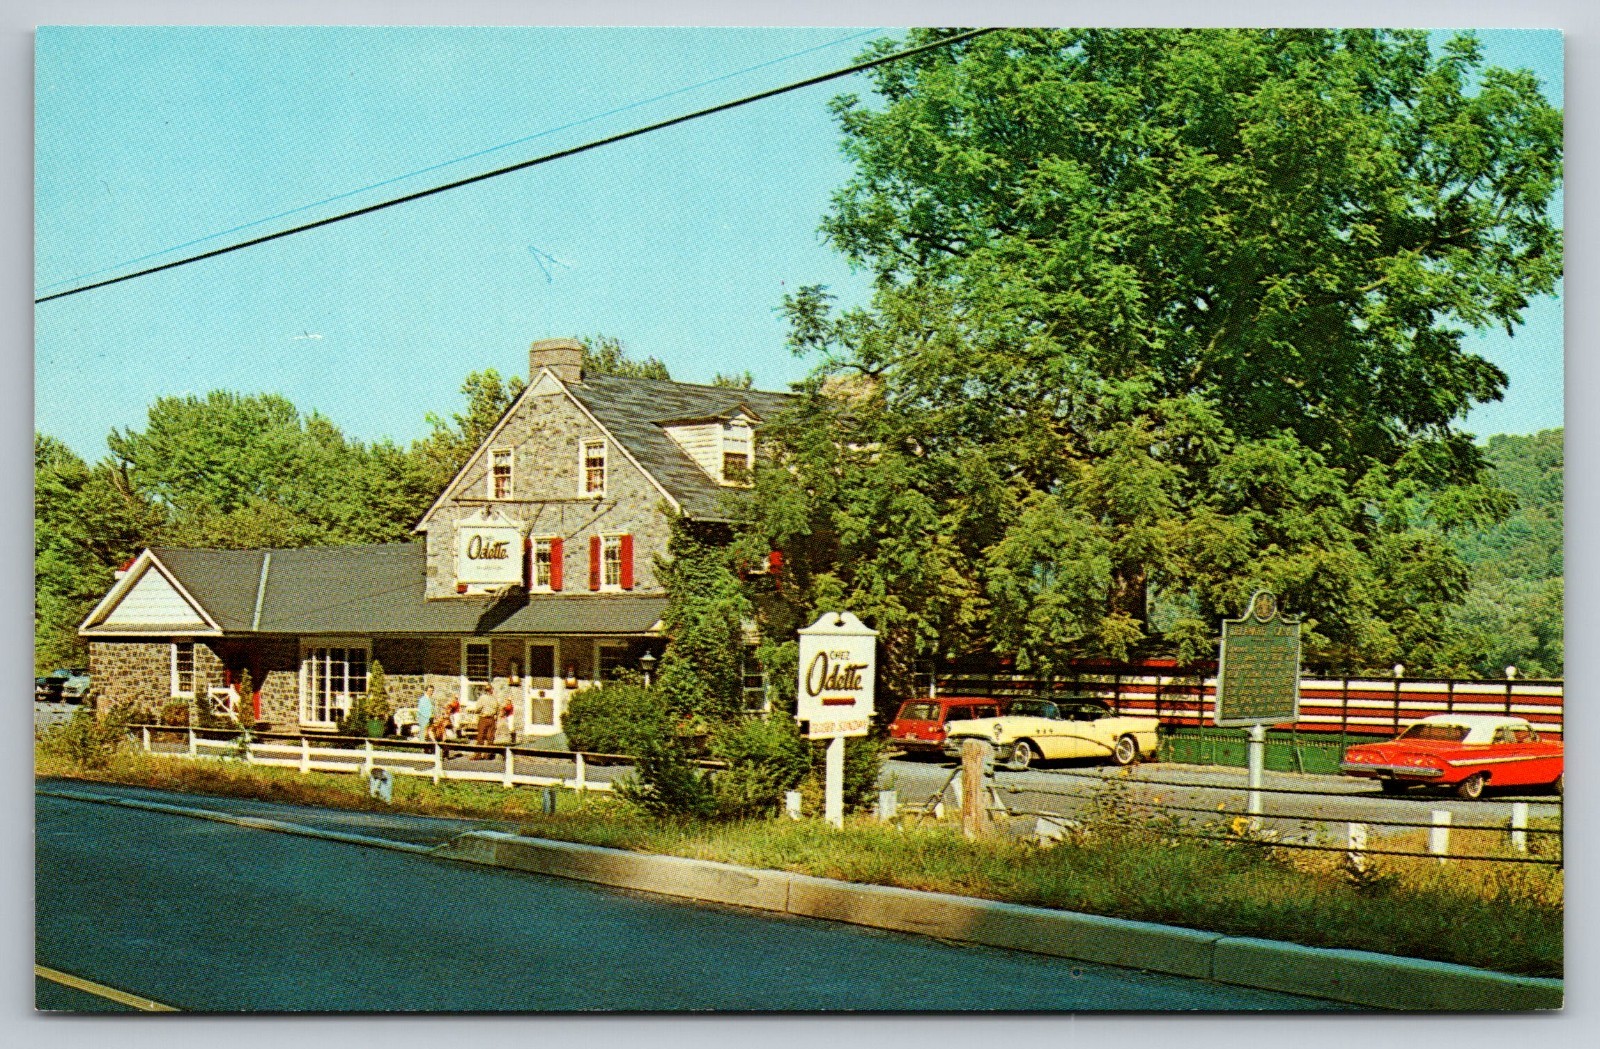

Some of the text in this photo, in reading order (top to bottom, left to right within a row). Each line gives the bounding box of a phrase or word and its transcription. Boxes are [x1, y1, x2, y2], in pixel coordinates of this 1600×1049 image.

[467, 534, 510, 560] Odette
[830, 650, 850, 661] CHEZ
[805, 651, 869, 697] Odette
